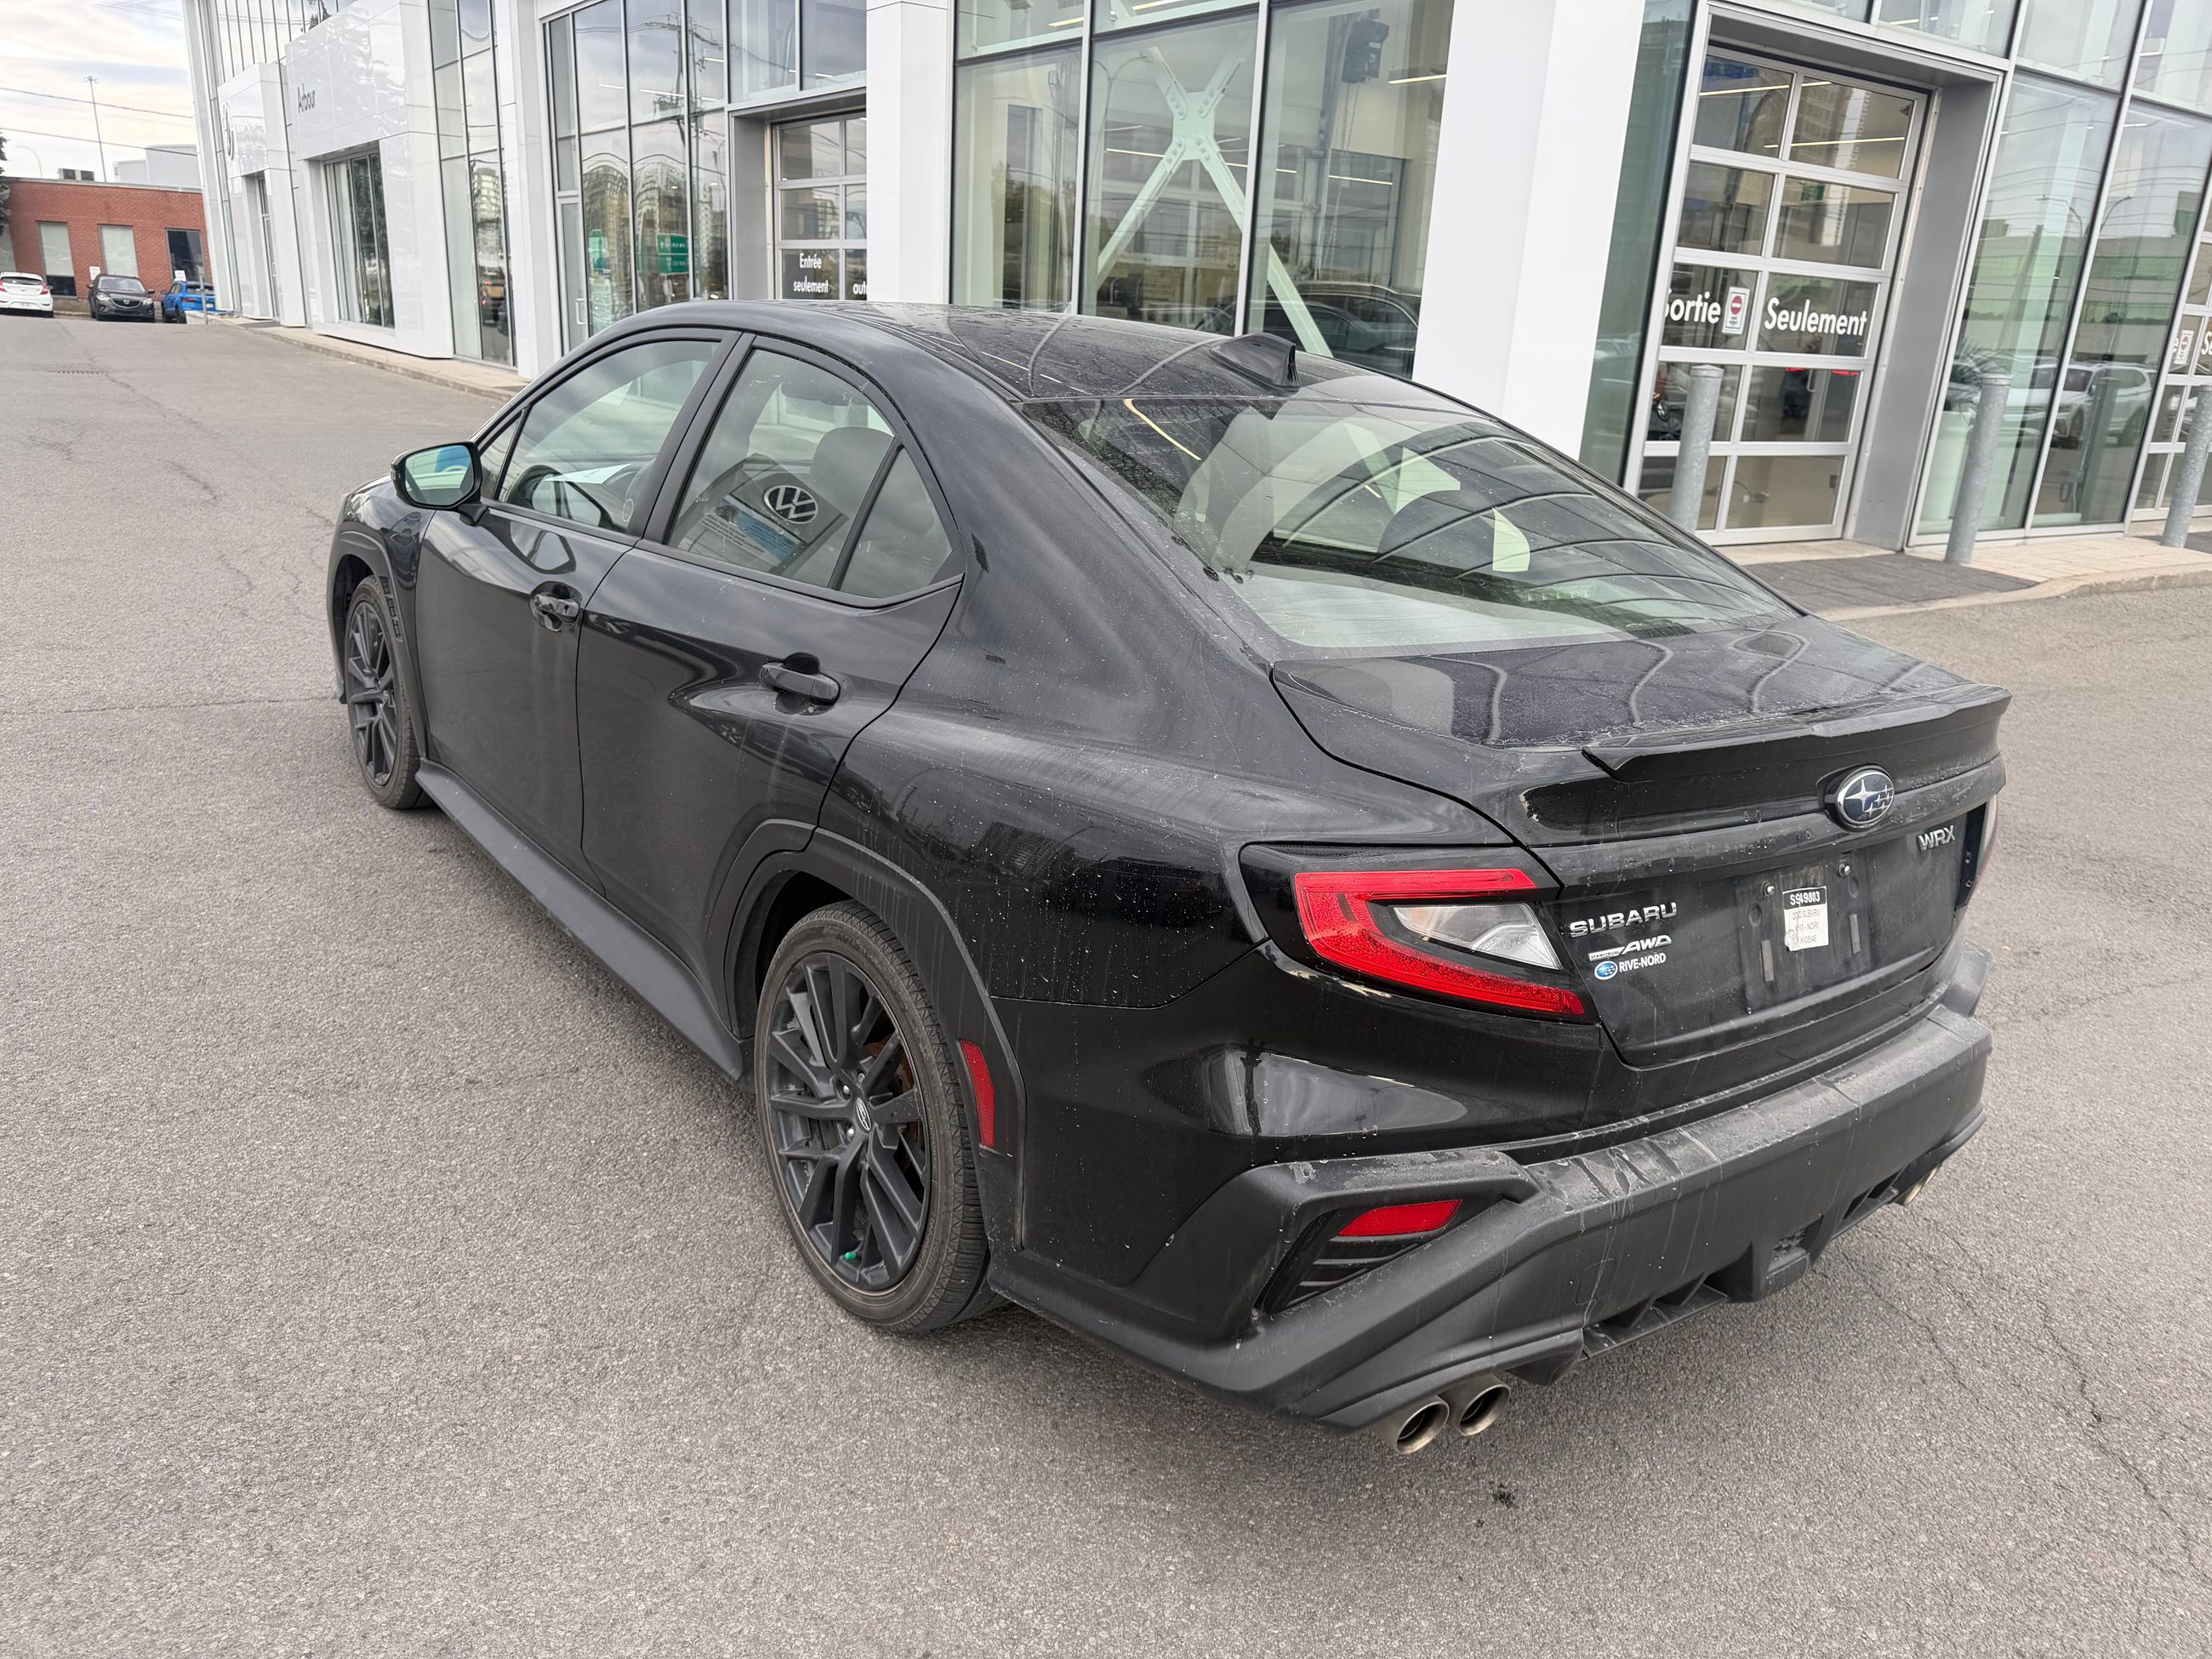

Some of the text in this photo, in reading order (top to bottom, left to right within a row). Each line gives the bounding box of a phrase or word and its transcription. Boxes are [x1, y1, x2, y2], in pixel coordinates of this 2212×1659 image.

[800, 253, 822, 269] Entrée
[793, 276, 830, 294] seulement
[1764, 297, 1867, 336] Seulement
[1918, 824, 1956, 851] WRX
[1569, 902, 1678, 938] SUBARU
[1622, 934, 1673, 955] AWD
[1618, 952, 1667, 972] RIVE-NORD
